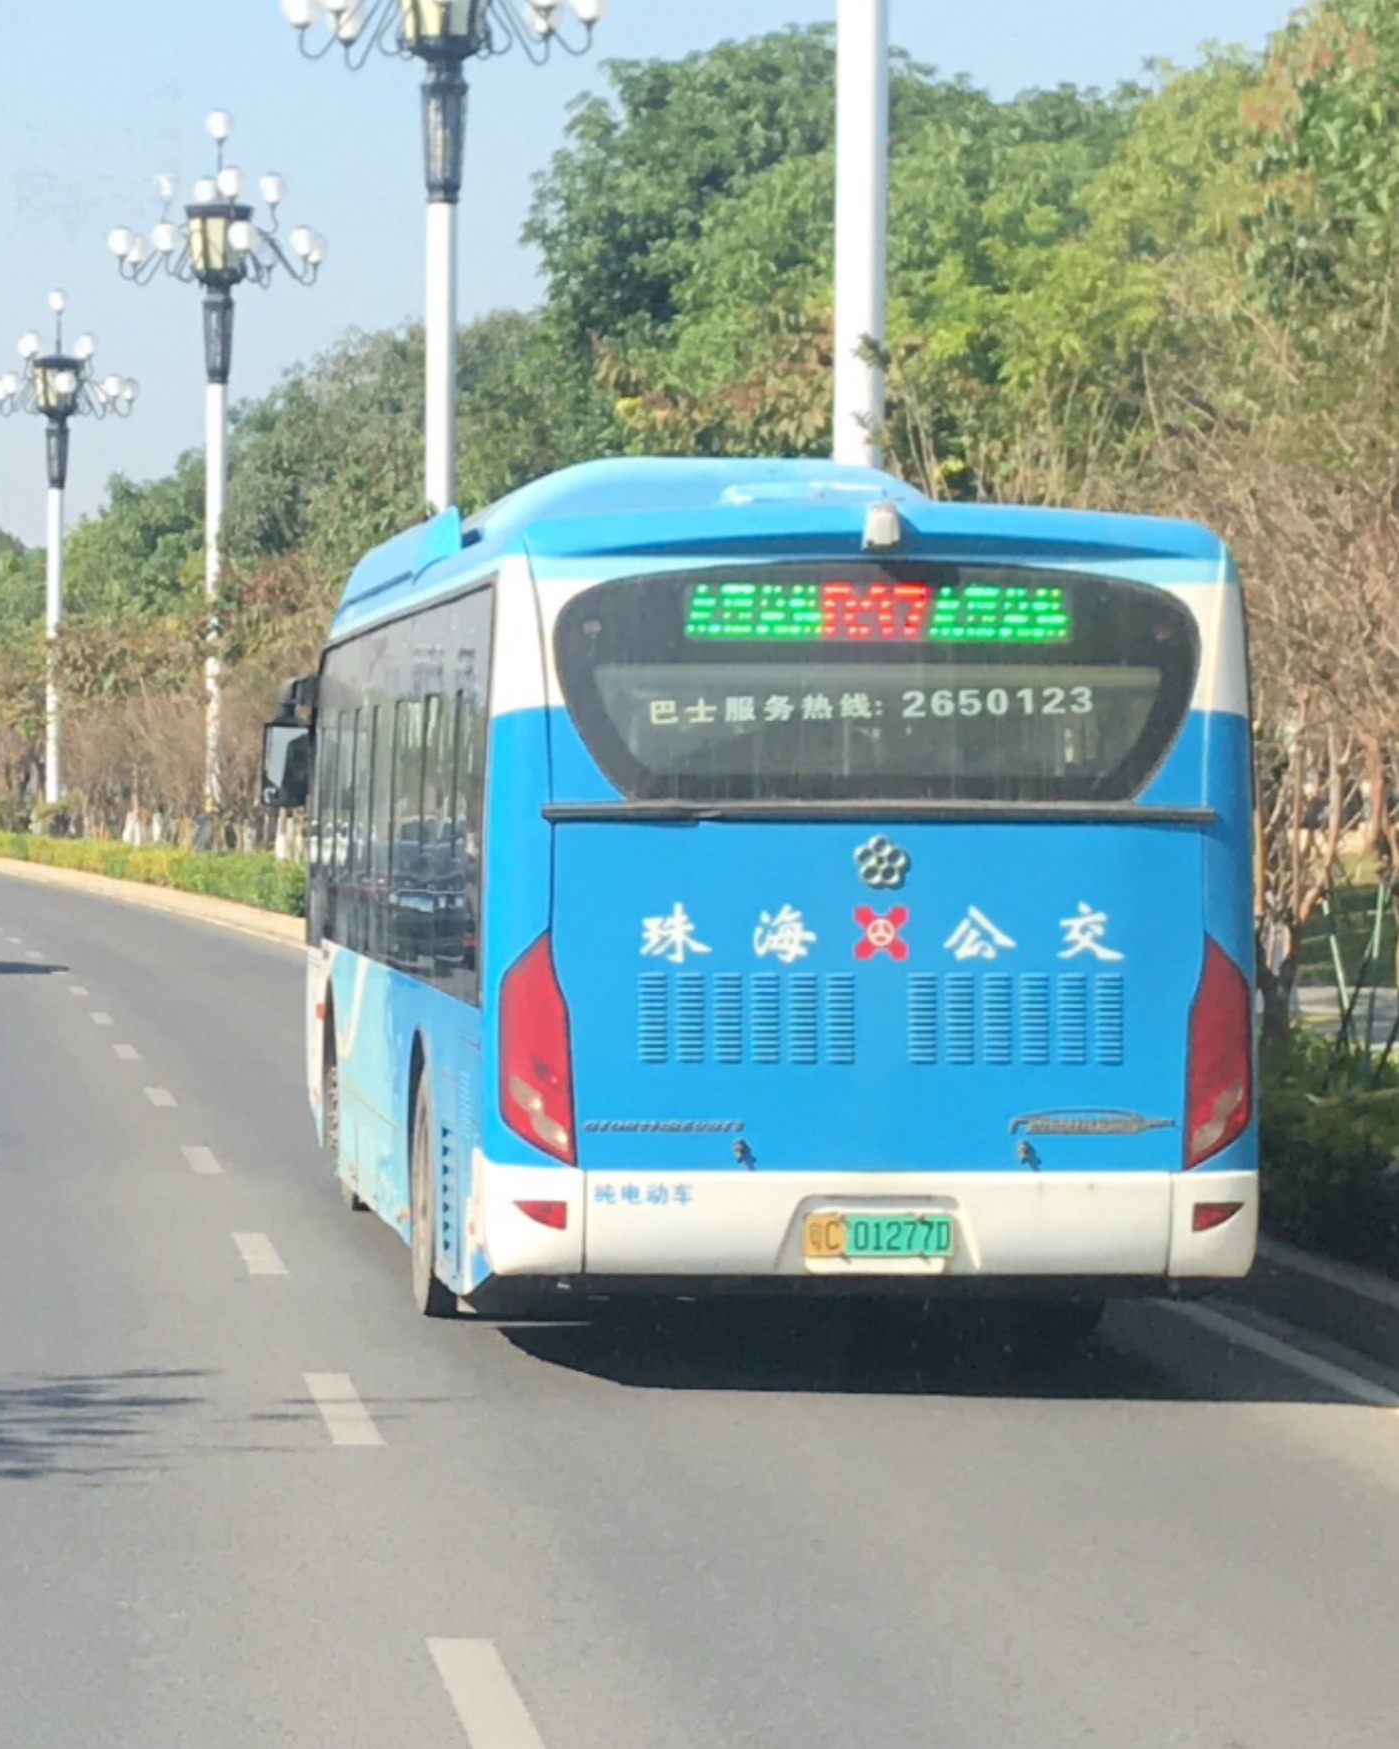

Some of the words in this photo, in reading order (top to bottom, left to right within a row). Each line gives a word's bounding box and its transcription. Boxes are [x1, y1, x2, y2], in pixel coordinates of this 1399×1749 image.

[902, 686, 1093, 717] 2650123
[639, 902, 817, 964] 珠海
[943, 902, 1125, 961] 公交
[593, 1182, 693, 1206] 纯电动车
